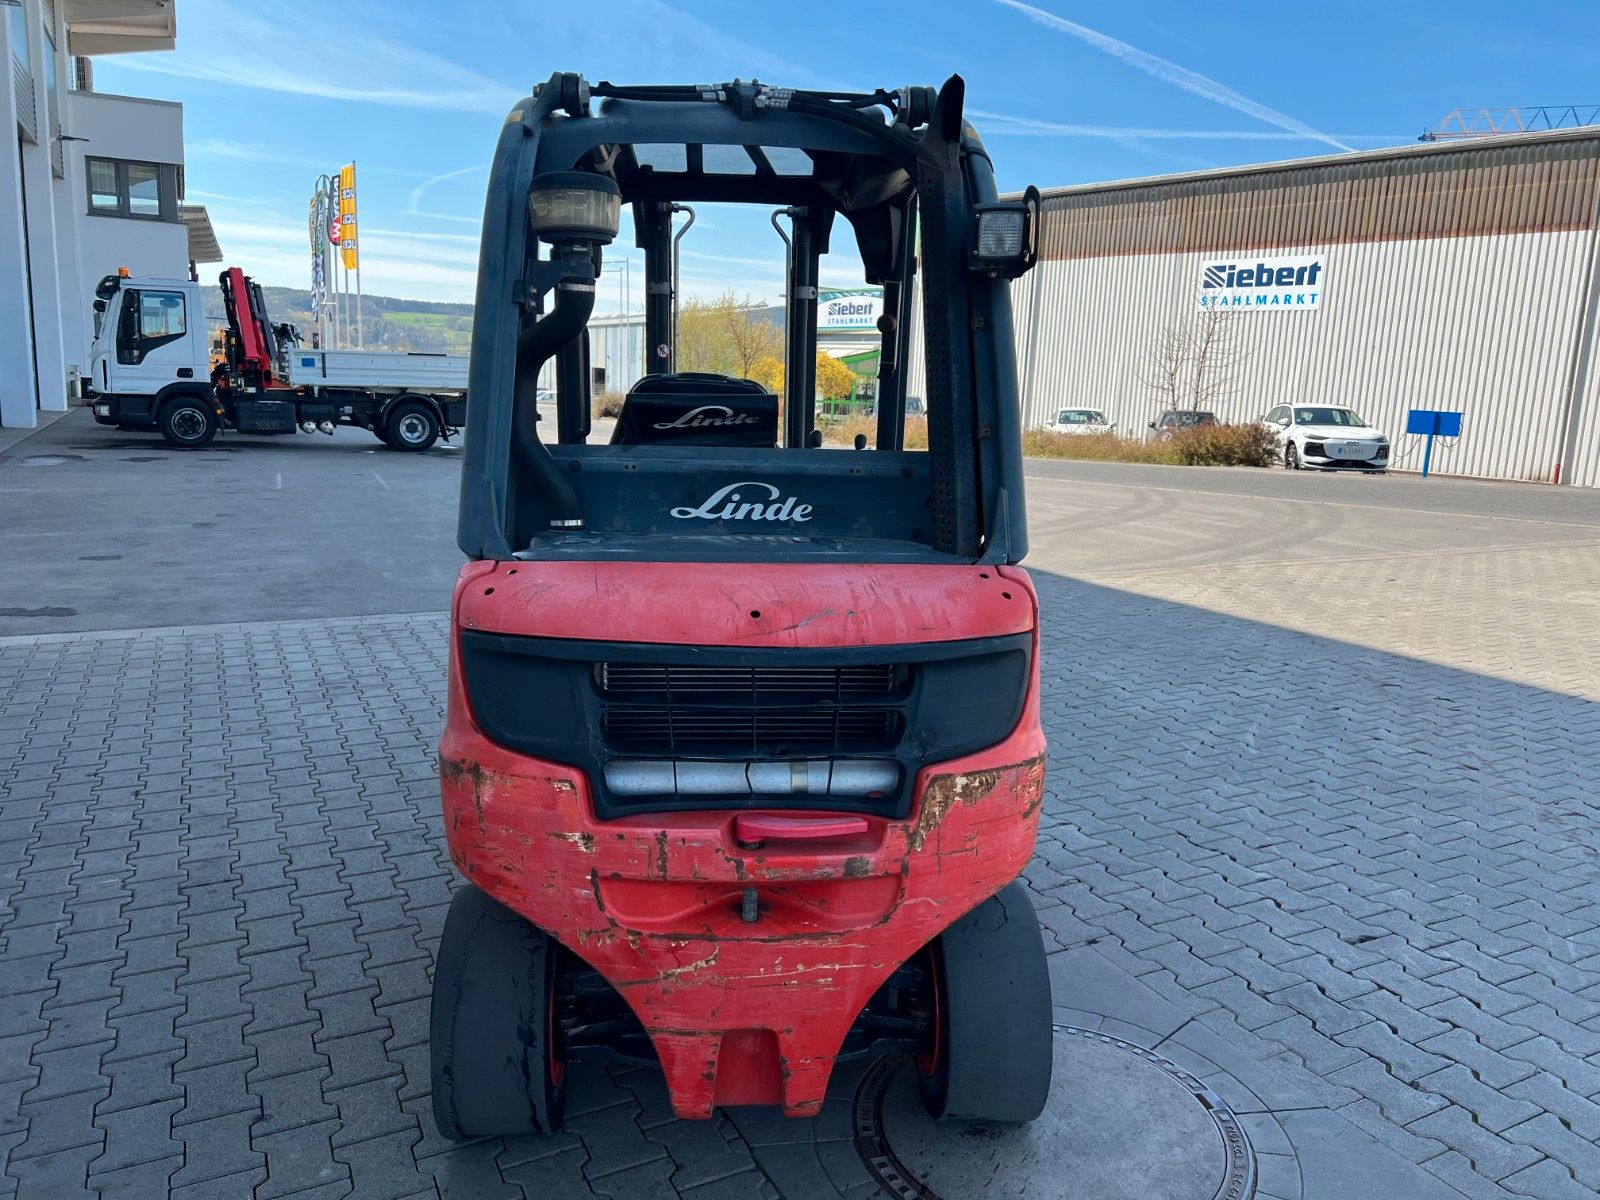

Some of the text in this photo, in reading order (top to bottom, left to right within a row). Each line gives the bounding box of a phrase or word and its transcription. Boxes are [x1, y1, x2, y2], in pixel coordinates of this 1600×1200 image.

[1203, 261, 1321, 288] Siebert
[828, 302, 873, 316] Siebert
[1201, 293, 1318, 306] STAHLMARKT
[653, 405, 760, 430] Linde
[670, 481, 813, 522] Linde
